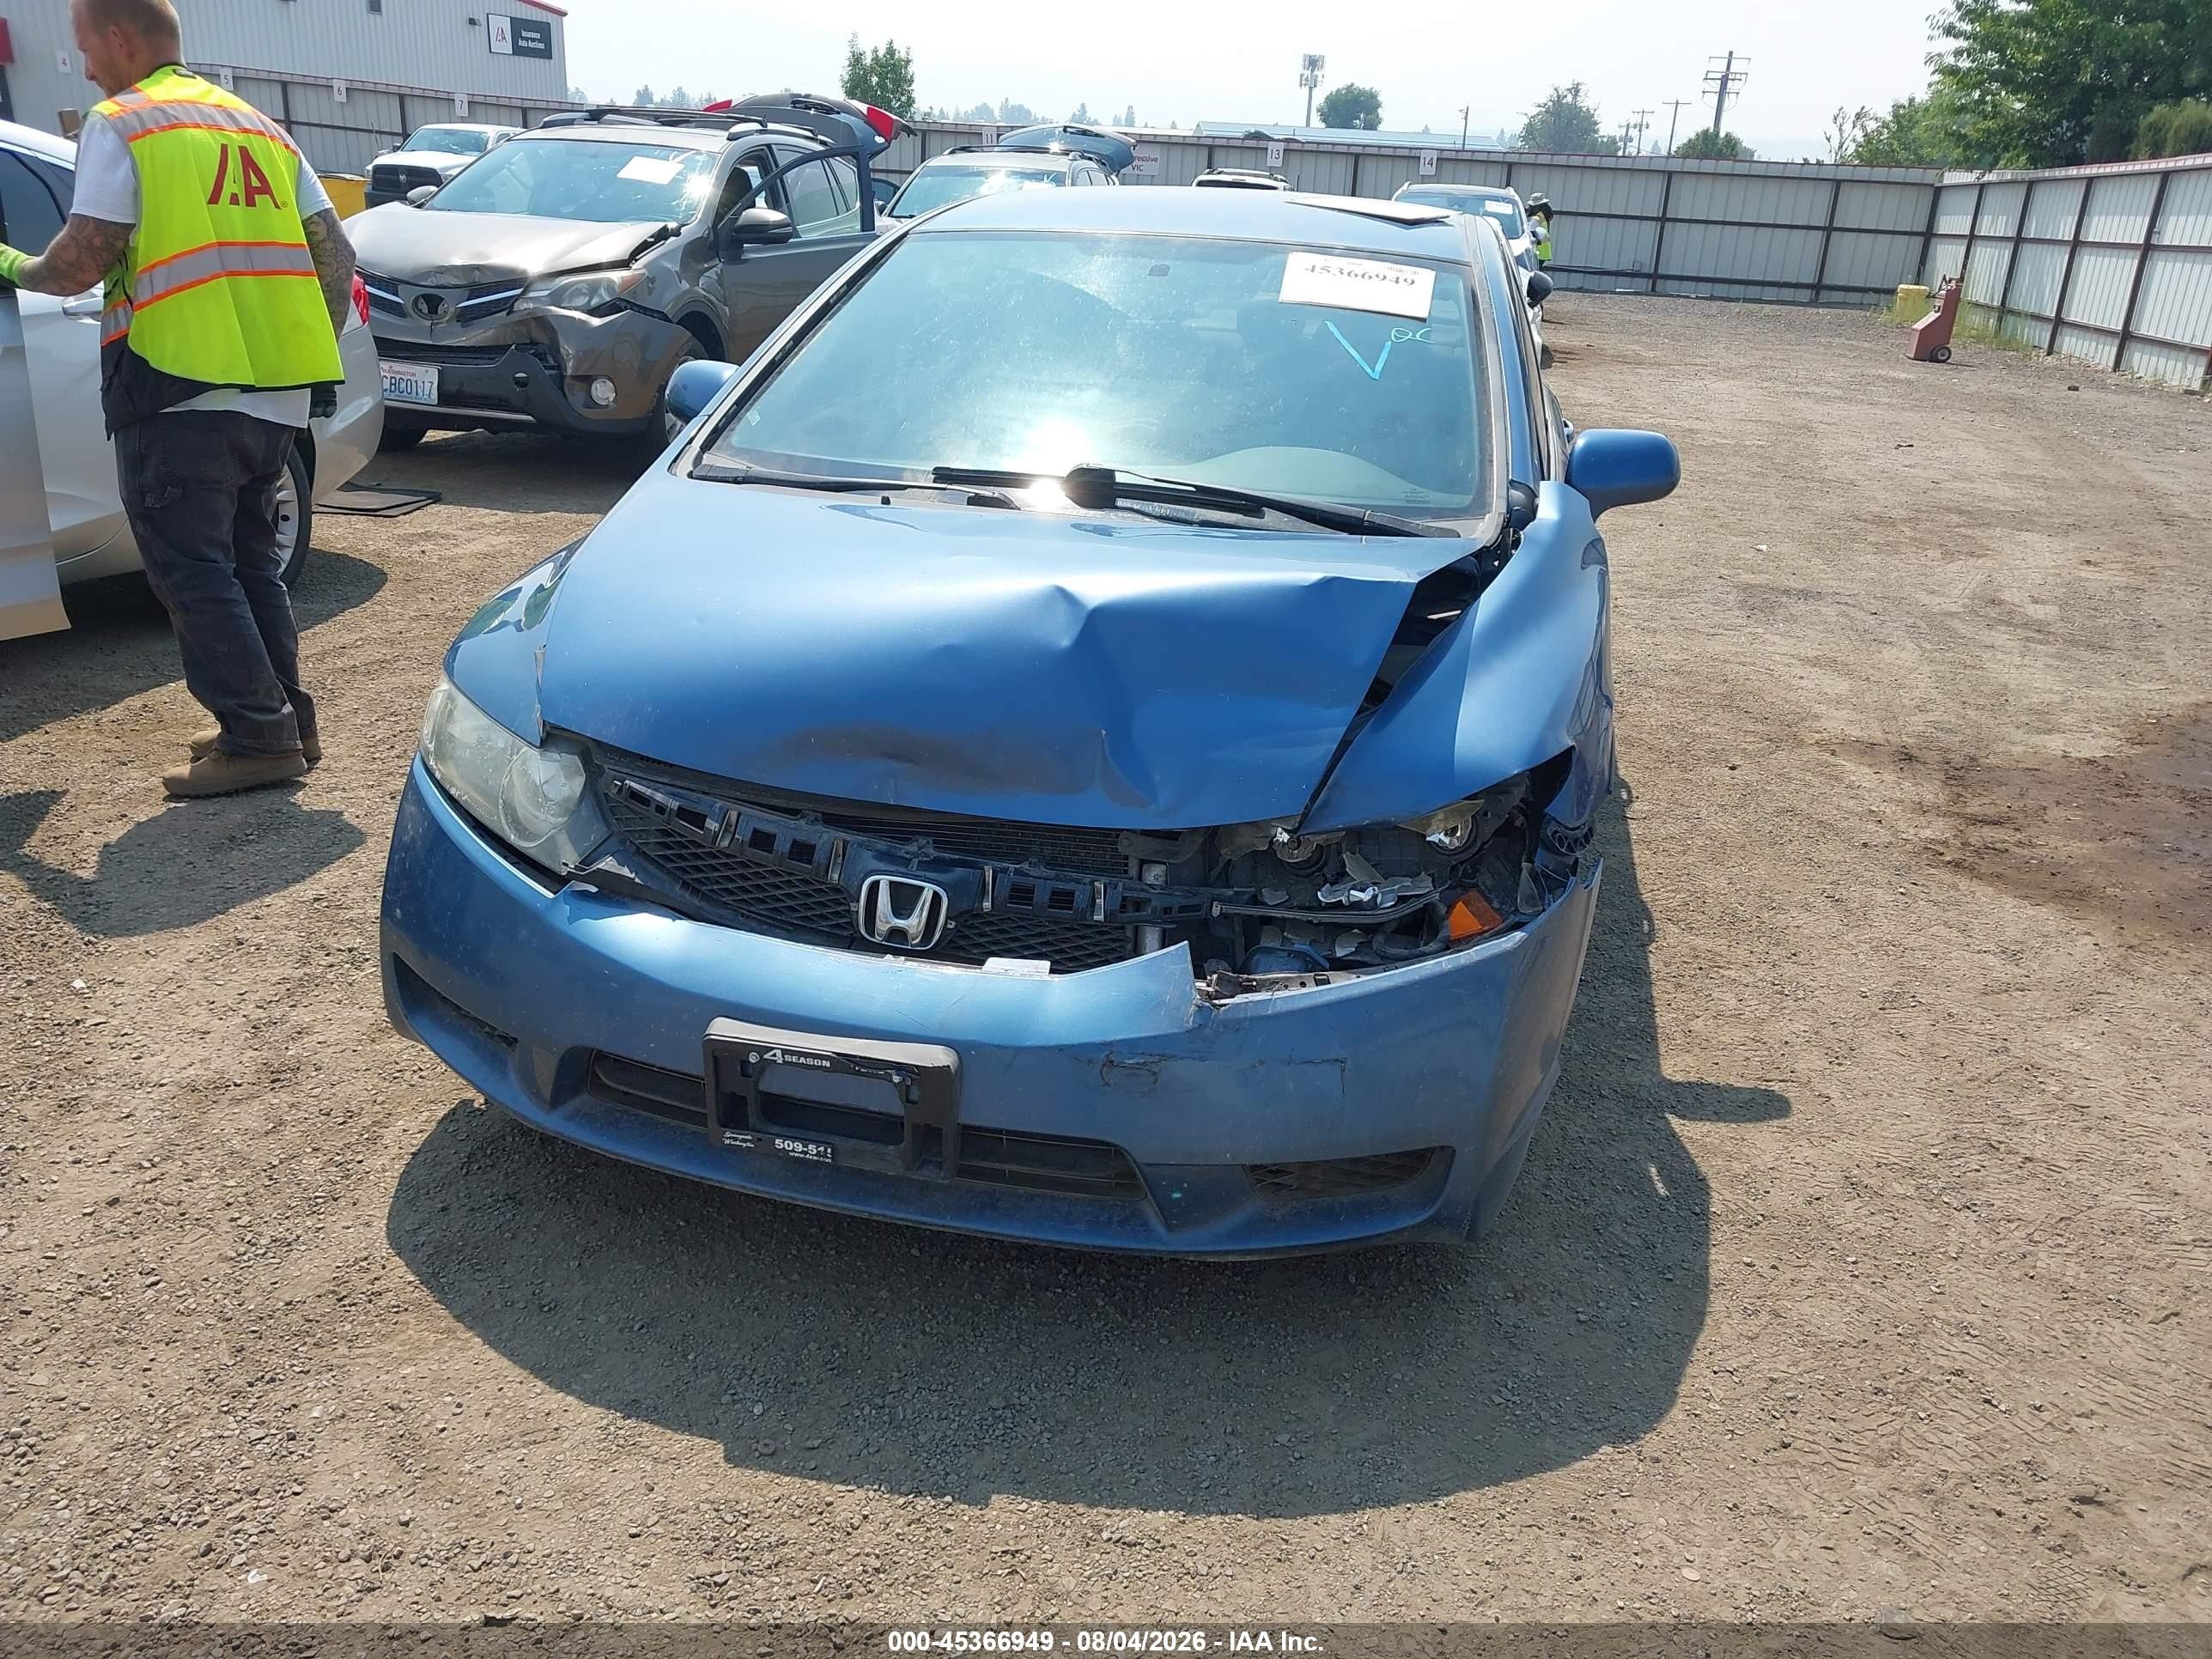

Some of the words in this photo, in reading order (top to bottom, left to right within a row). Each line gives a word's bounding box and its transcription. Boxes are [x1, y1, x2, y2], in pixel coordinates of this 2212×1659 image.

[520, 27, 541, 40] Insurance
[518, 38, 528, 47] Auto
[528, 39, 545, 49] Auctions
[223, 75, 229, 84] 5
[337, 87, 343, 96] 6
[459, 100, 464, 110] 7
[986, 133, 994, 144] 11
[1133, 155, 1159, 163] ressive
[1270, 149, 1280, 160] 13
[1423, 156, 1434, 167] 14
[1305, 264, 1416, 287] 45366949
[784, 1054, 830, 1067] SEASON
